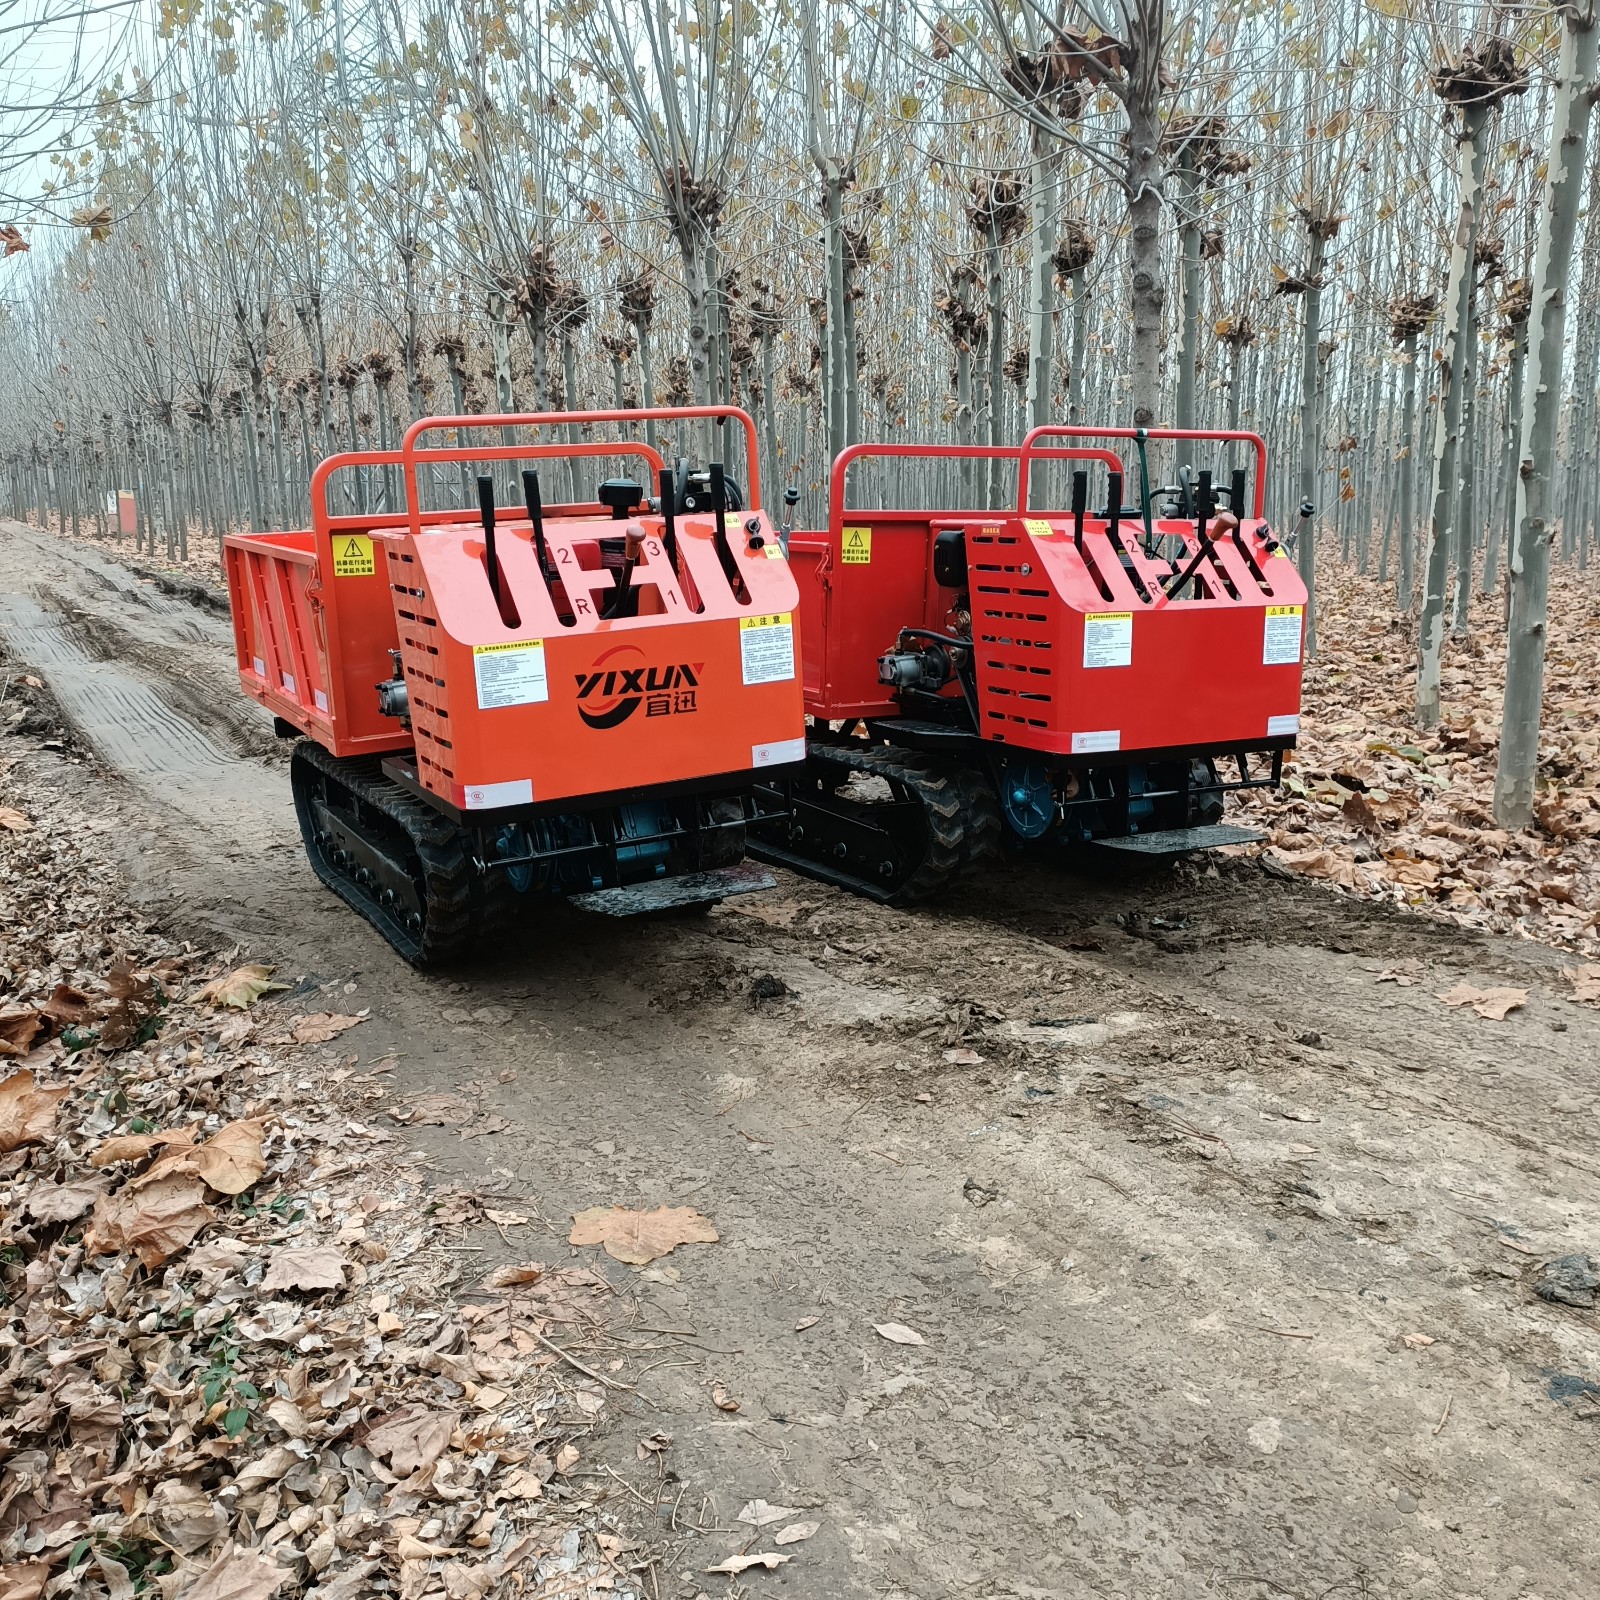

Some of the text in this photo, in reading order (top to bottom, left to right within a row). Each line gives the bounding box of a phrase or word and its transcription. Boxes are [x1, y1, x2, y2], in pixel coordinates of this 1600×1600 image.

[647, 540, 661, 556] 3
[1126, 539, 1139, 553] 2
[1188, 538, 1200, 552] 3
[556, 547, 572, 564] 2
[1147, 581, 1163, 596] R
[1211, 579, 1221, 593] 1
[667, 589, 678, 605] 1
[575, 598, 592, 614] R
[759, 614, 781, 626] 注意
[574, 662, 705, 699] YIXUN
[645, 690, 698, 718] 宜迅
